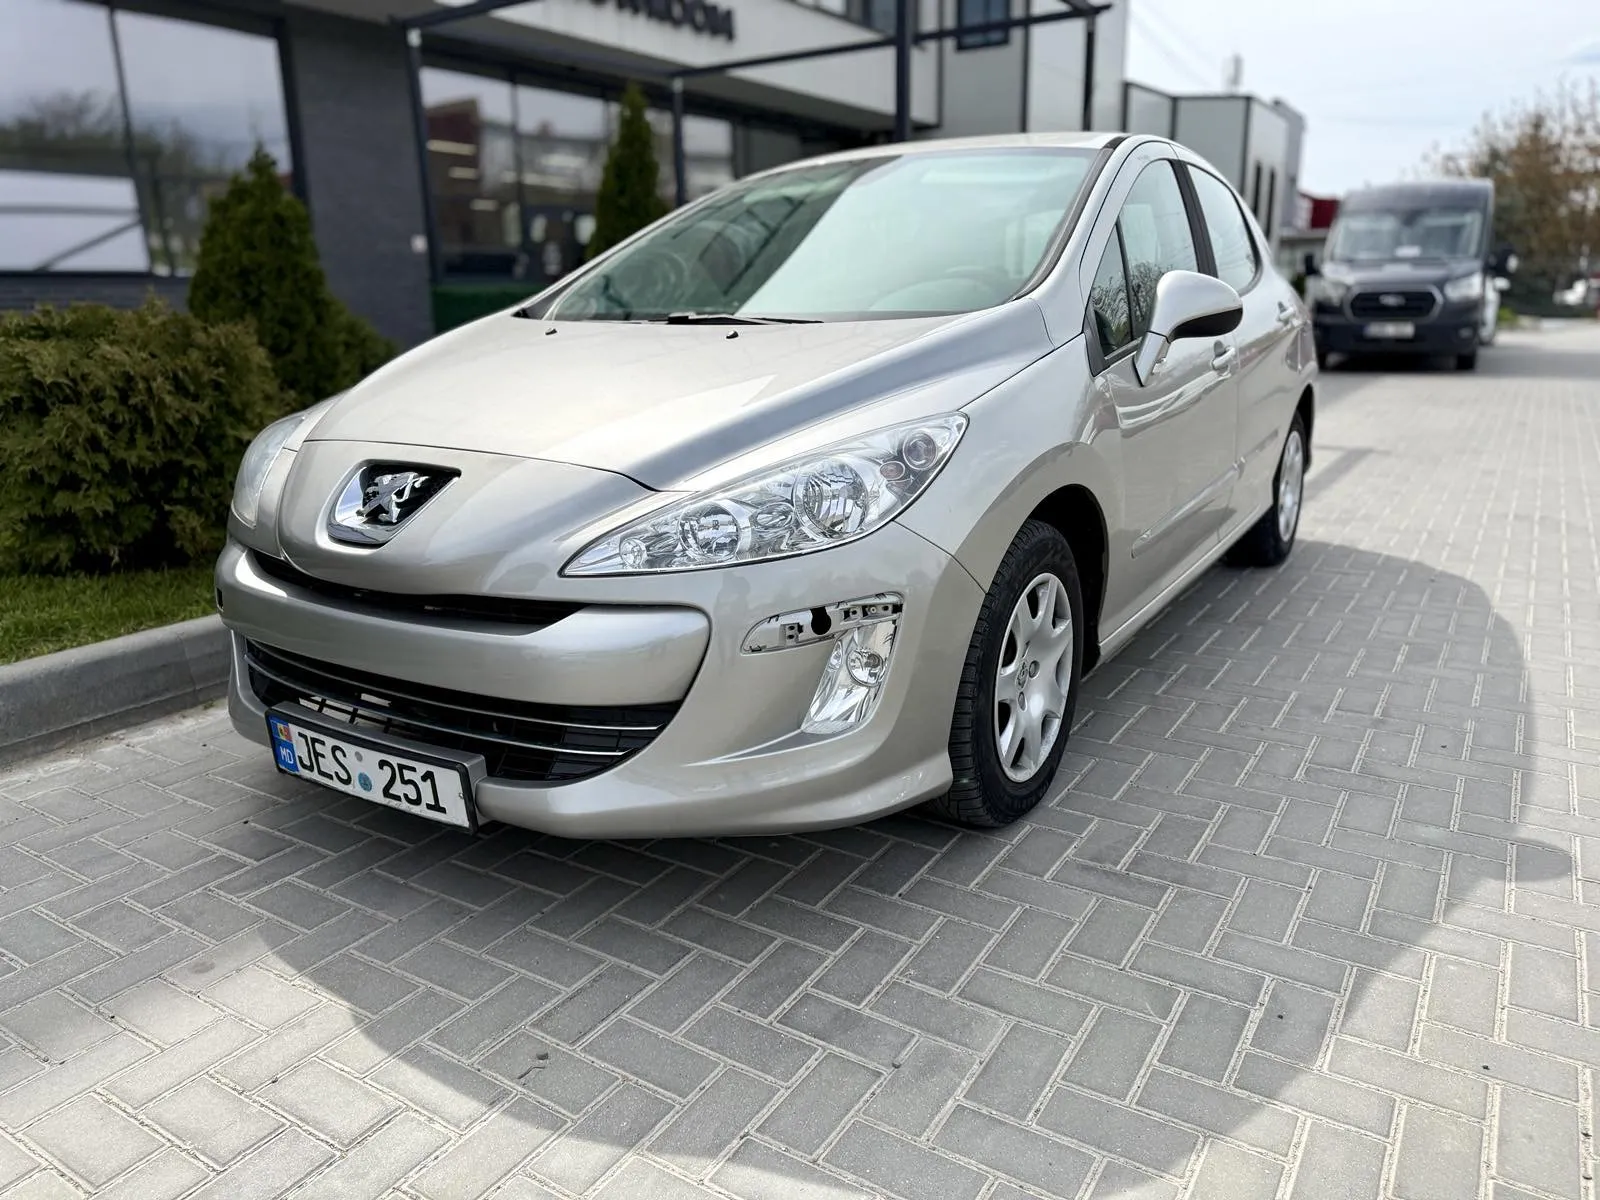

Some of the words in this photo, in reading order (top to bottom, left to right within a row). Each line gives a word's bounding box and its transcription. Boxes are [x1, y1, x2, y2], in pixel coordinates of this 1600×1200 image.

[280, 746, 294, 764] MD
[298, 731, 352, 786] JES
[378, 759, 447, 814] 251
